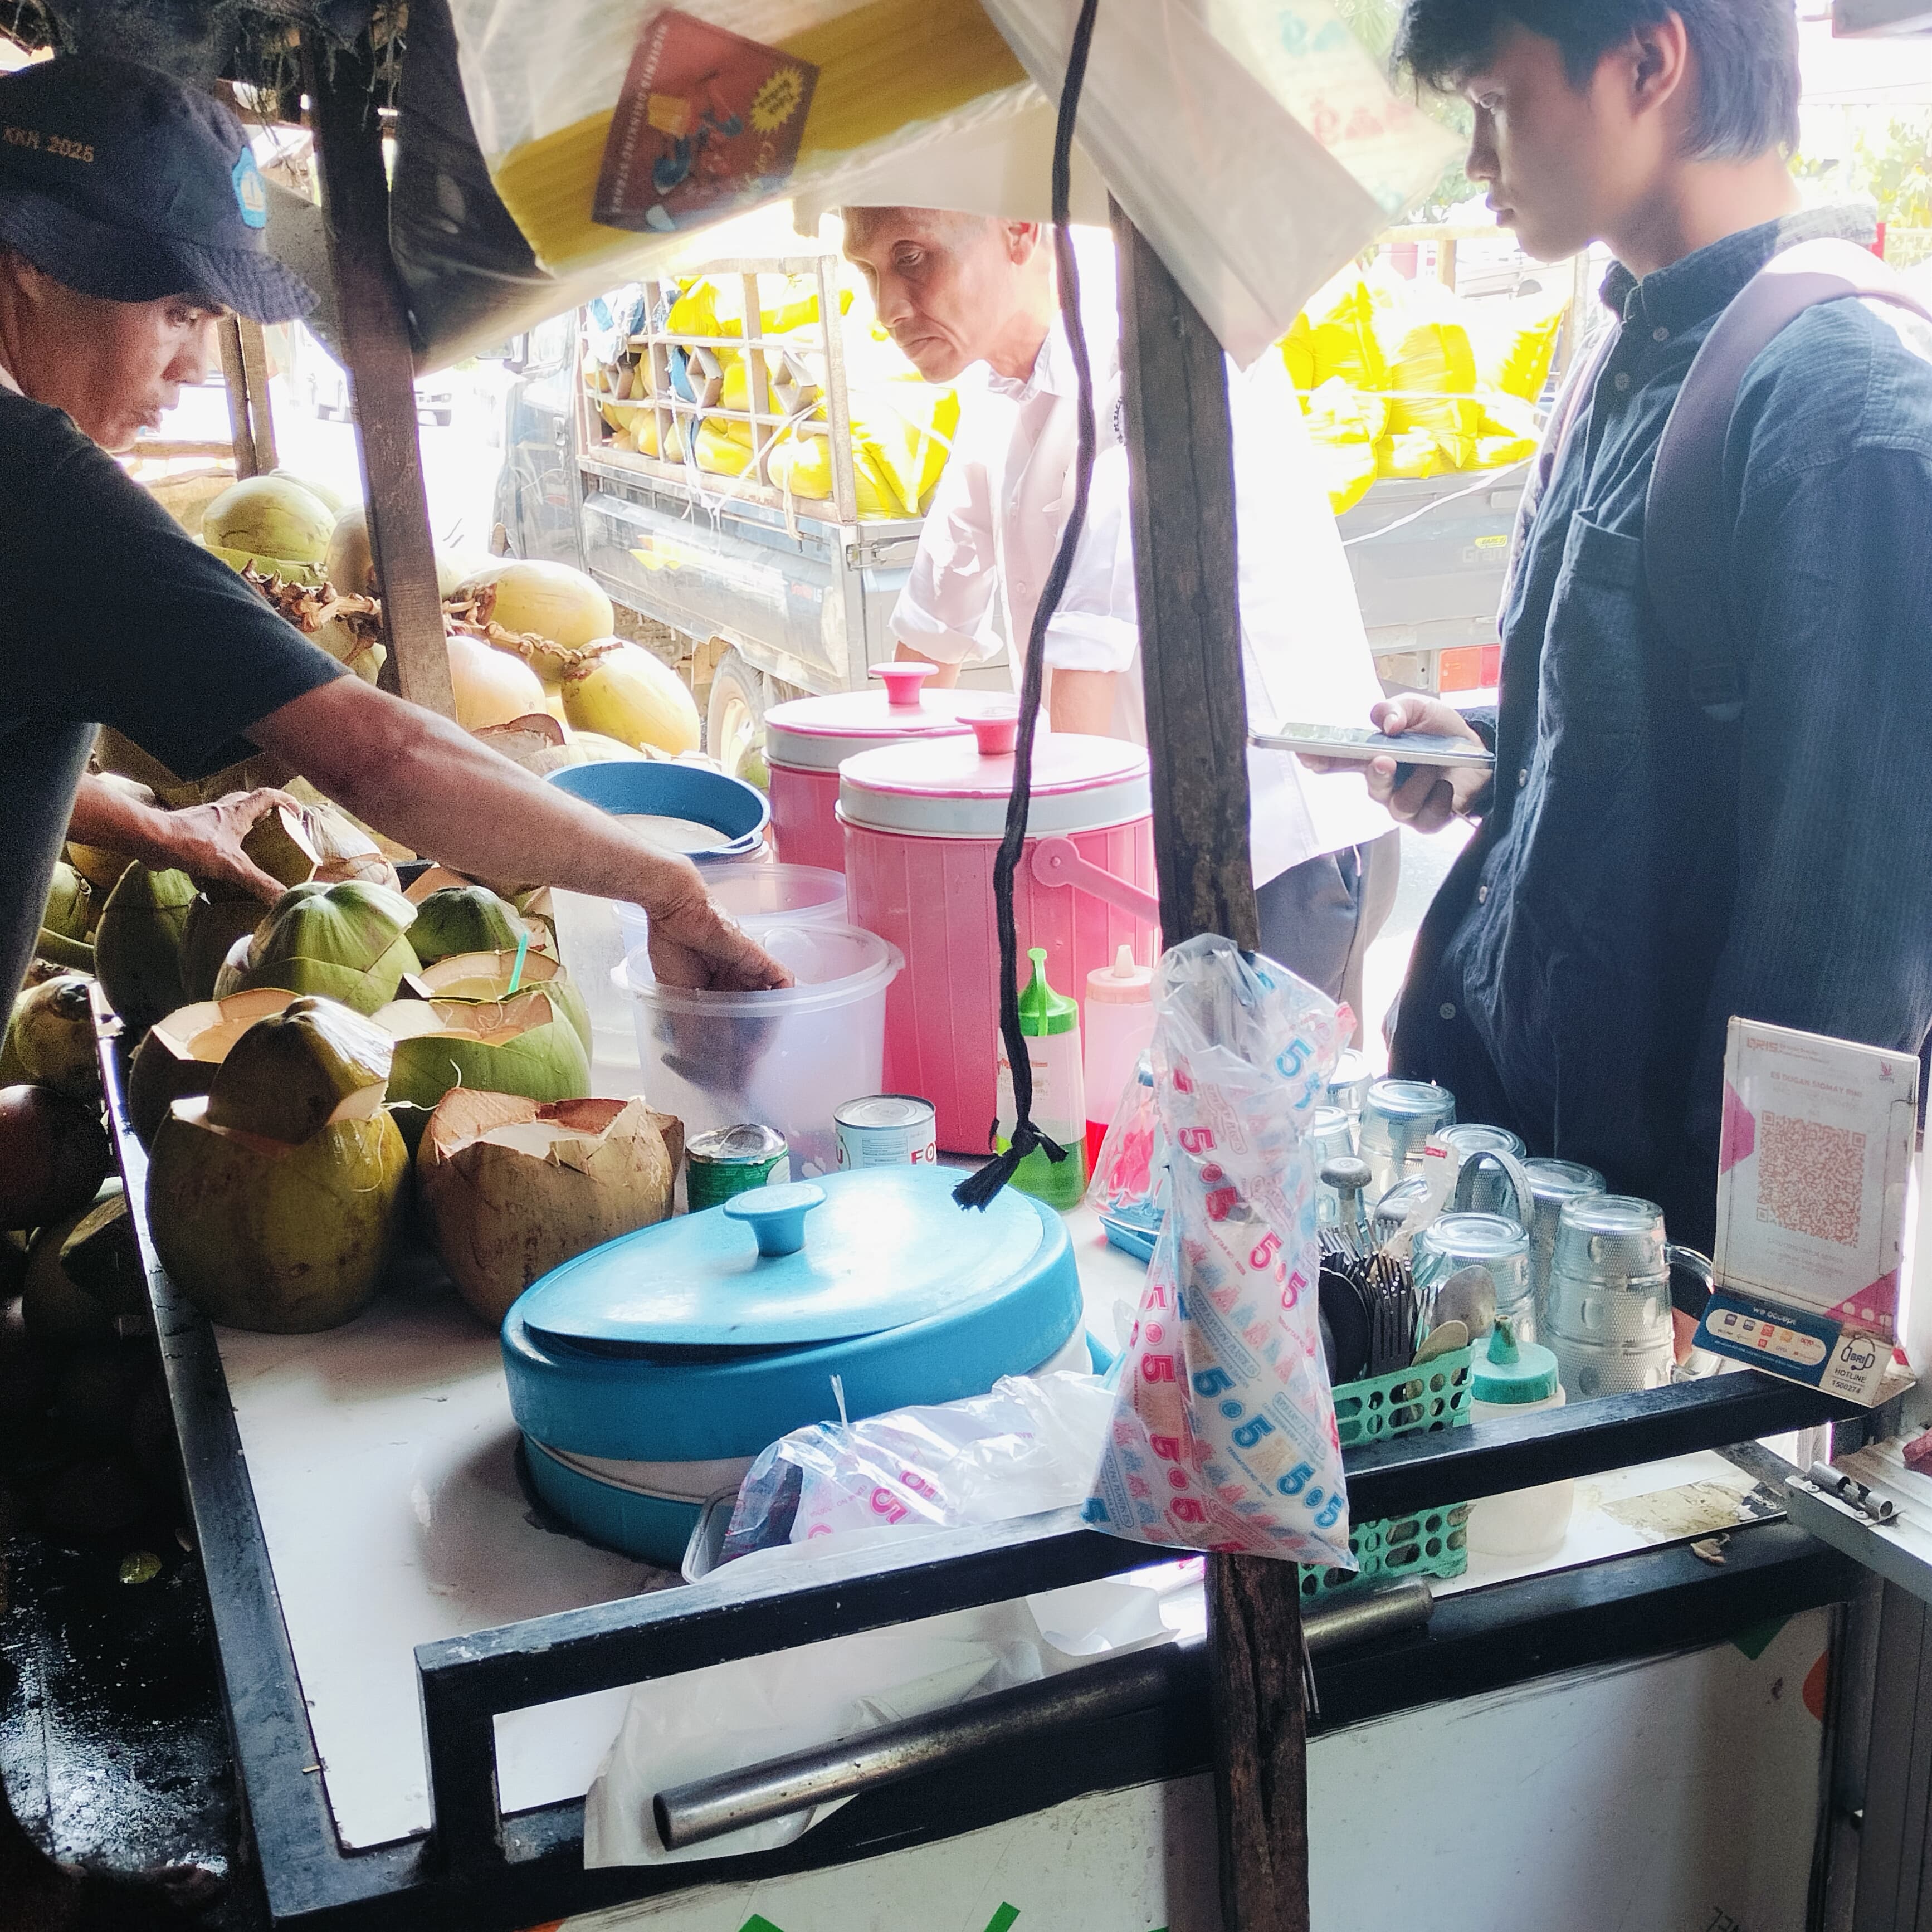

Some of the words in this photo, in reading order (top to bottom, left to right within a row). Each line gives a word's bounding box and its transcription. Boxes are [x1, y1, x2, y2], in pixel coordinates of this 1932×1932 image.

[1276, 1038, 1314, 1079] 5
[1178, 1126, 1217, 1155] 5
[1206, 1186, 1238, 1222] 5
[1248, 1230, 1284, 1271] 5
[1282, 1271, 1308, 1310] 5
[1141, 1354, 1176, 1383] 5
[1835, 1368, 1867, 1383] HOTLINE
[1850, 1353, 1865, 1363] BRI
[1192, 1367, 1236, 1398] 5
[1232, 1413, 1276, 1450] 5
[1277, 1461, 1316, 1496] 5
[1314, 1492, 1345, 1530] 5
[1150, 1435, 1182, 1463] 5
[1170, 1497, 1207, 1524] 5
[870, 1487, 910, 1525] 5
